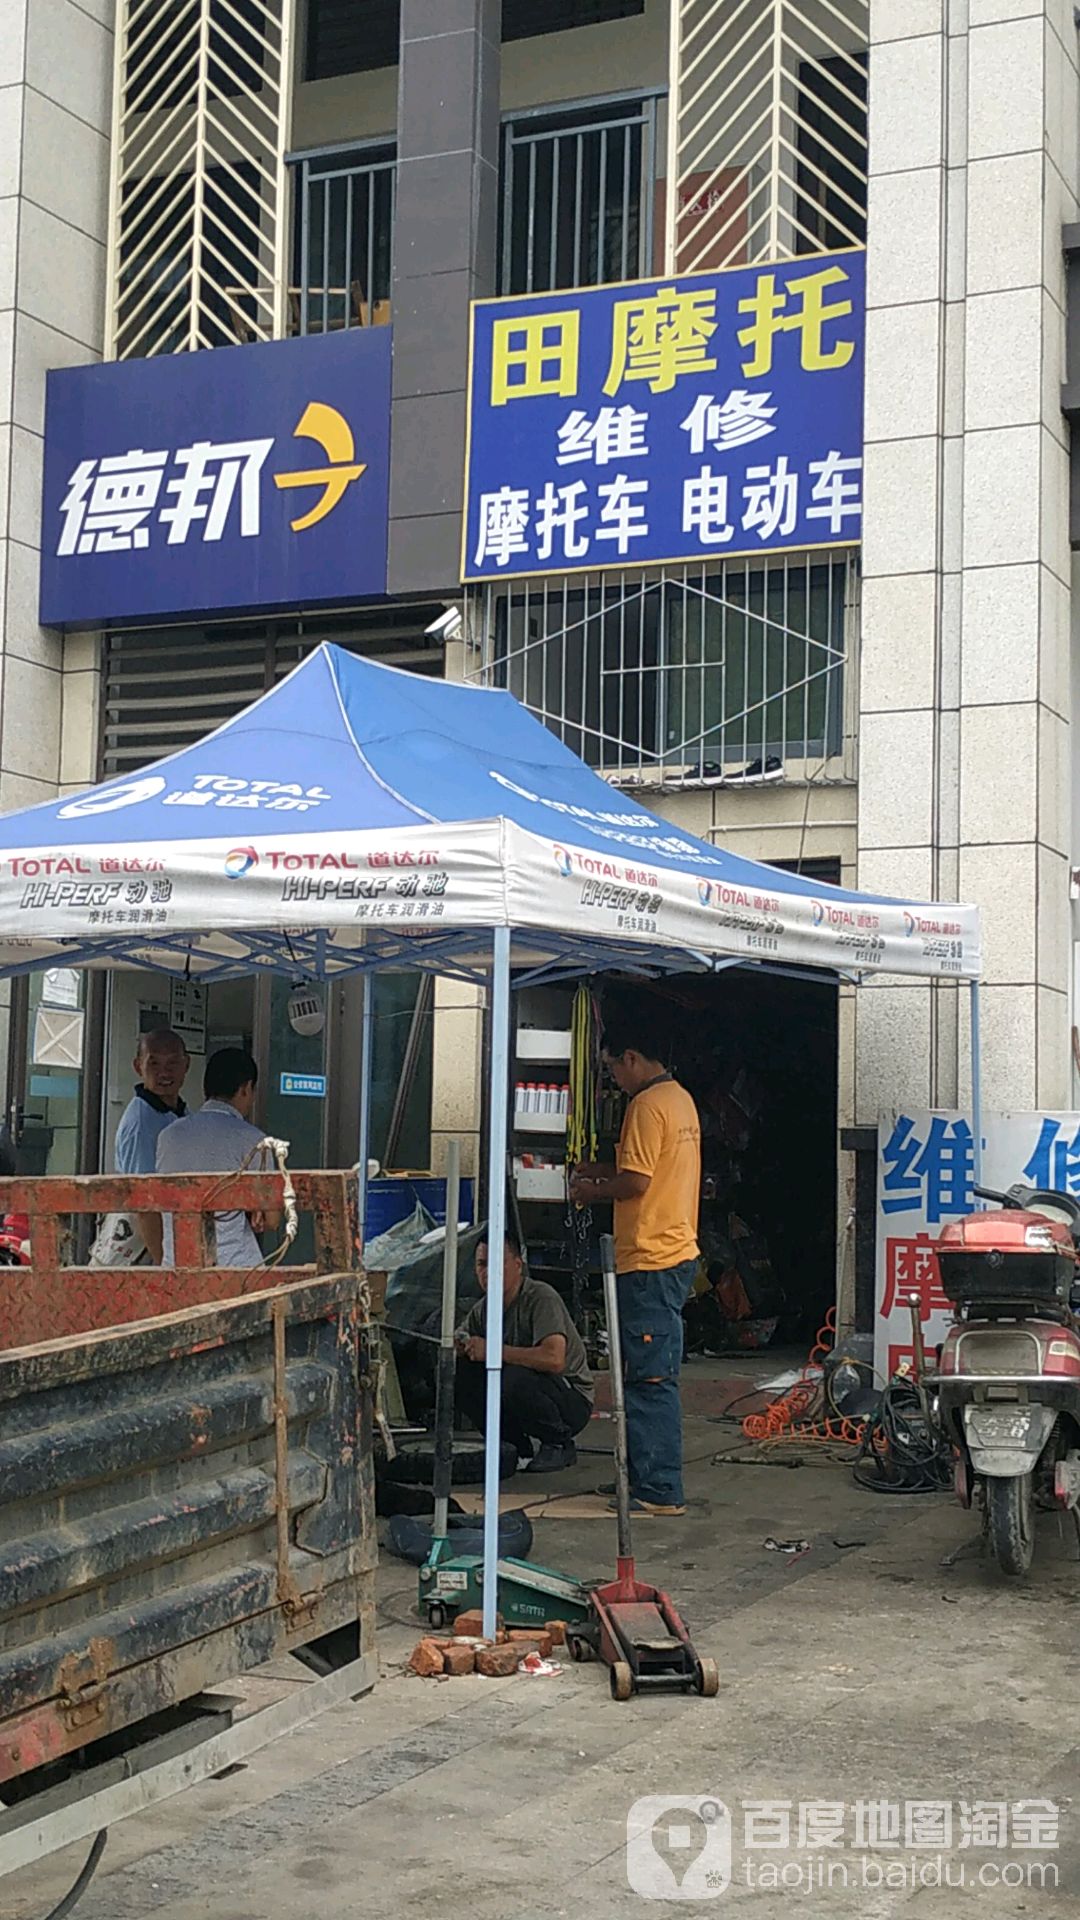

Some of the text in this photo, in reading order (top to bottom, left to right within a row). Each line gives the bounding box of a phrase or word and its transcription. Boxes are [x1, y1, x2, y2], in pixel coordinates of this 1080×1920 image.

[490, 266, 855, 407] 田摩托
[555, 390, 779, 466] 维修
[56, 438, 275, 556] 德邦
[474, 451, 863, 567] 摩托车 电动车
[193, 775, 332, 800] TOTAL
[162, 791, 321, 811] 道达尔
[8, 857, 167, 877] TOTAL 道达尔
[265, 850, 440, 870] TOTAL 道达尔
[573, 852, 621, 880] TOTAL
[20, 878, 173, 909] HI-PERF 动驰
[281, 871, 450, 901] HI-PERF 动驰
[580, 878, 639, 911] HI-PERF
[714, 883, 751, 907] TOTAL
[88, 909, 168, 924] 摩托车润滑油
[355, 902, 445, 918] 摩托车润滑油
[825, 906, 855, 926] TOTAL
[915, 916, 941, 933] TOTAL
